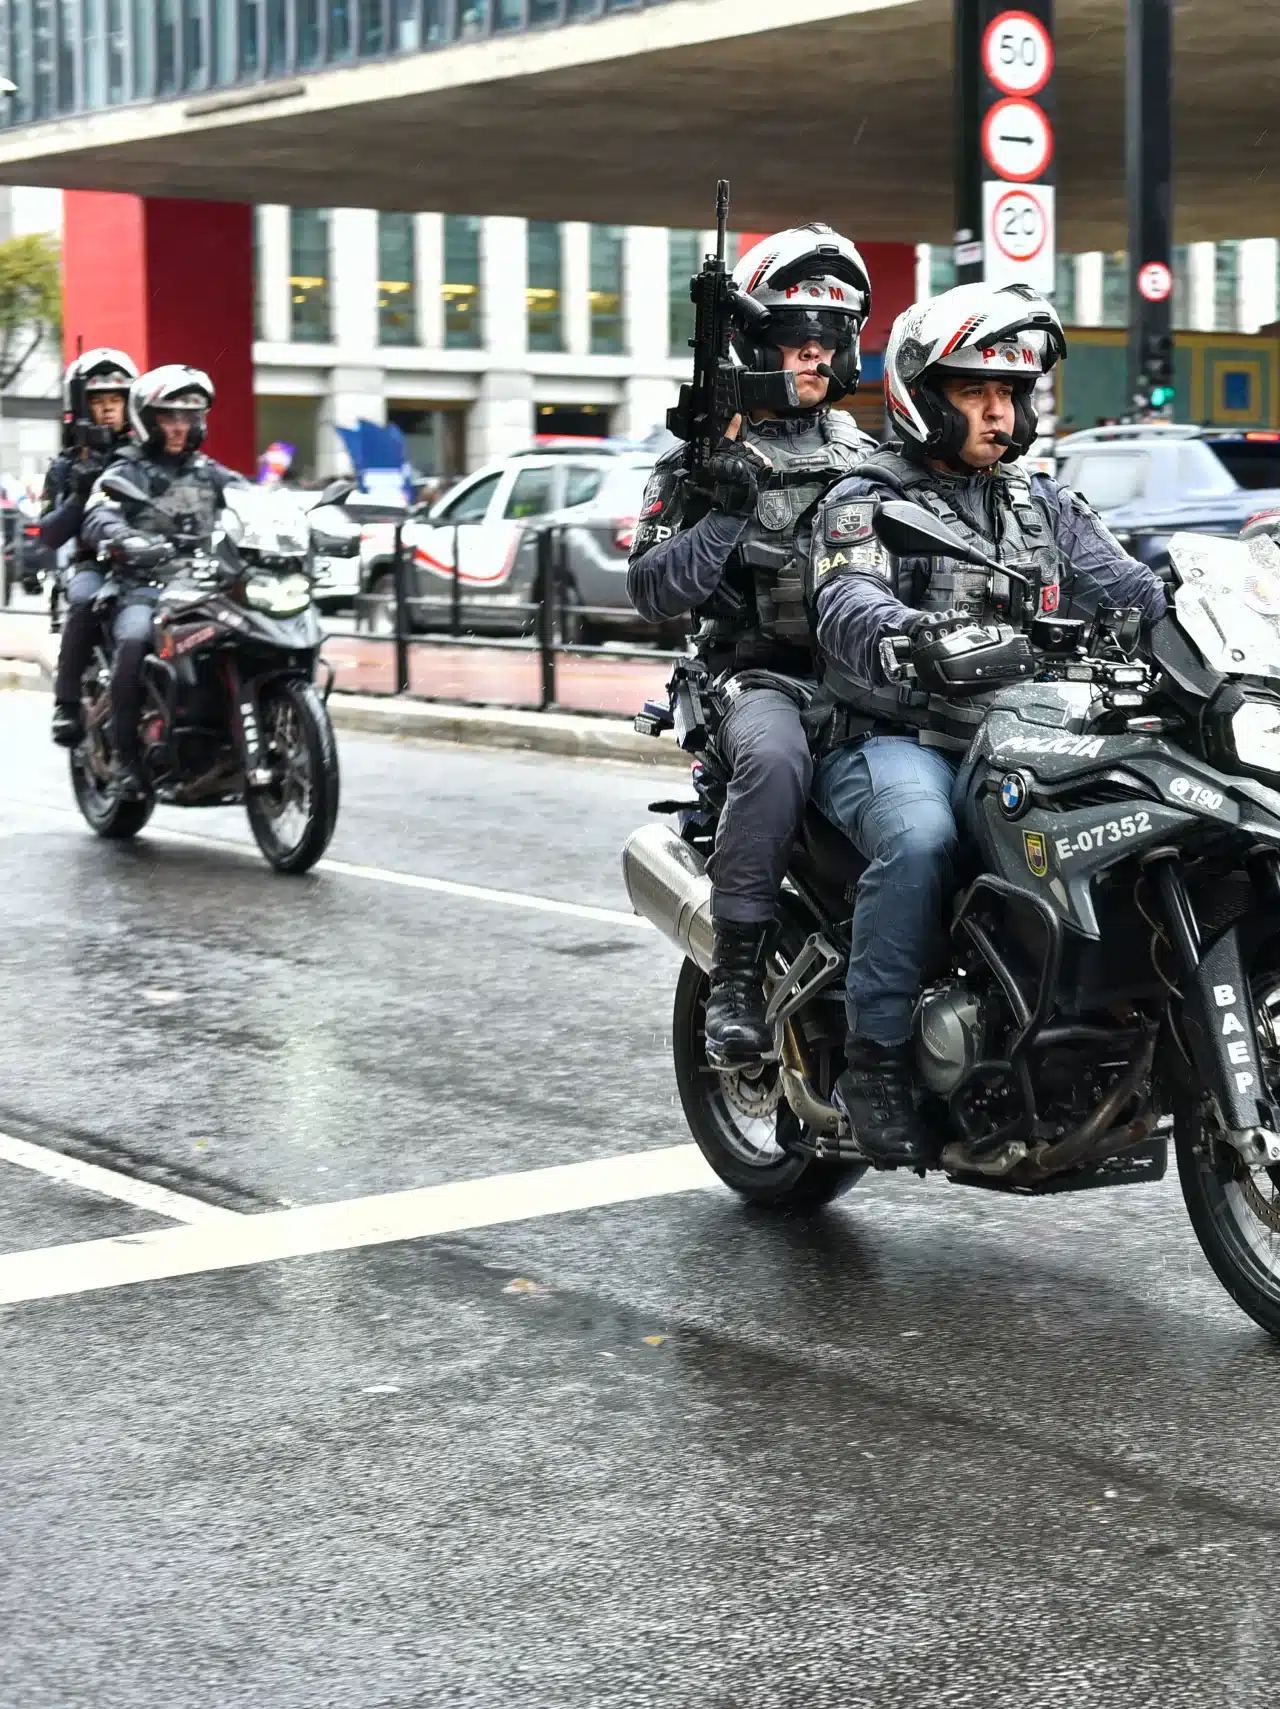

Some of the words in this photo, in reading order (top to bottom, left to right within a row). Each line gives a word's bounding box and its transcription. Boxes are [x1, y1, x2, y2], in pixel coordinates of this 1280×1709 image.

[1000, 34, 1037, 67] 50
[1003, 206, 1037, 236] 20
[785, 285, 799, 299] P
[827, 286, 845, 302] M
[982, 348, 997, 365] P
[1020, 348, 1035, 366] M
[817, 549, 884, 577] BAEP
[1189, 785, 1223, 810] 190
[1054, 811, 1153, 861] E-07352
[1212, 984, 1254, 1094] BAEP
